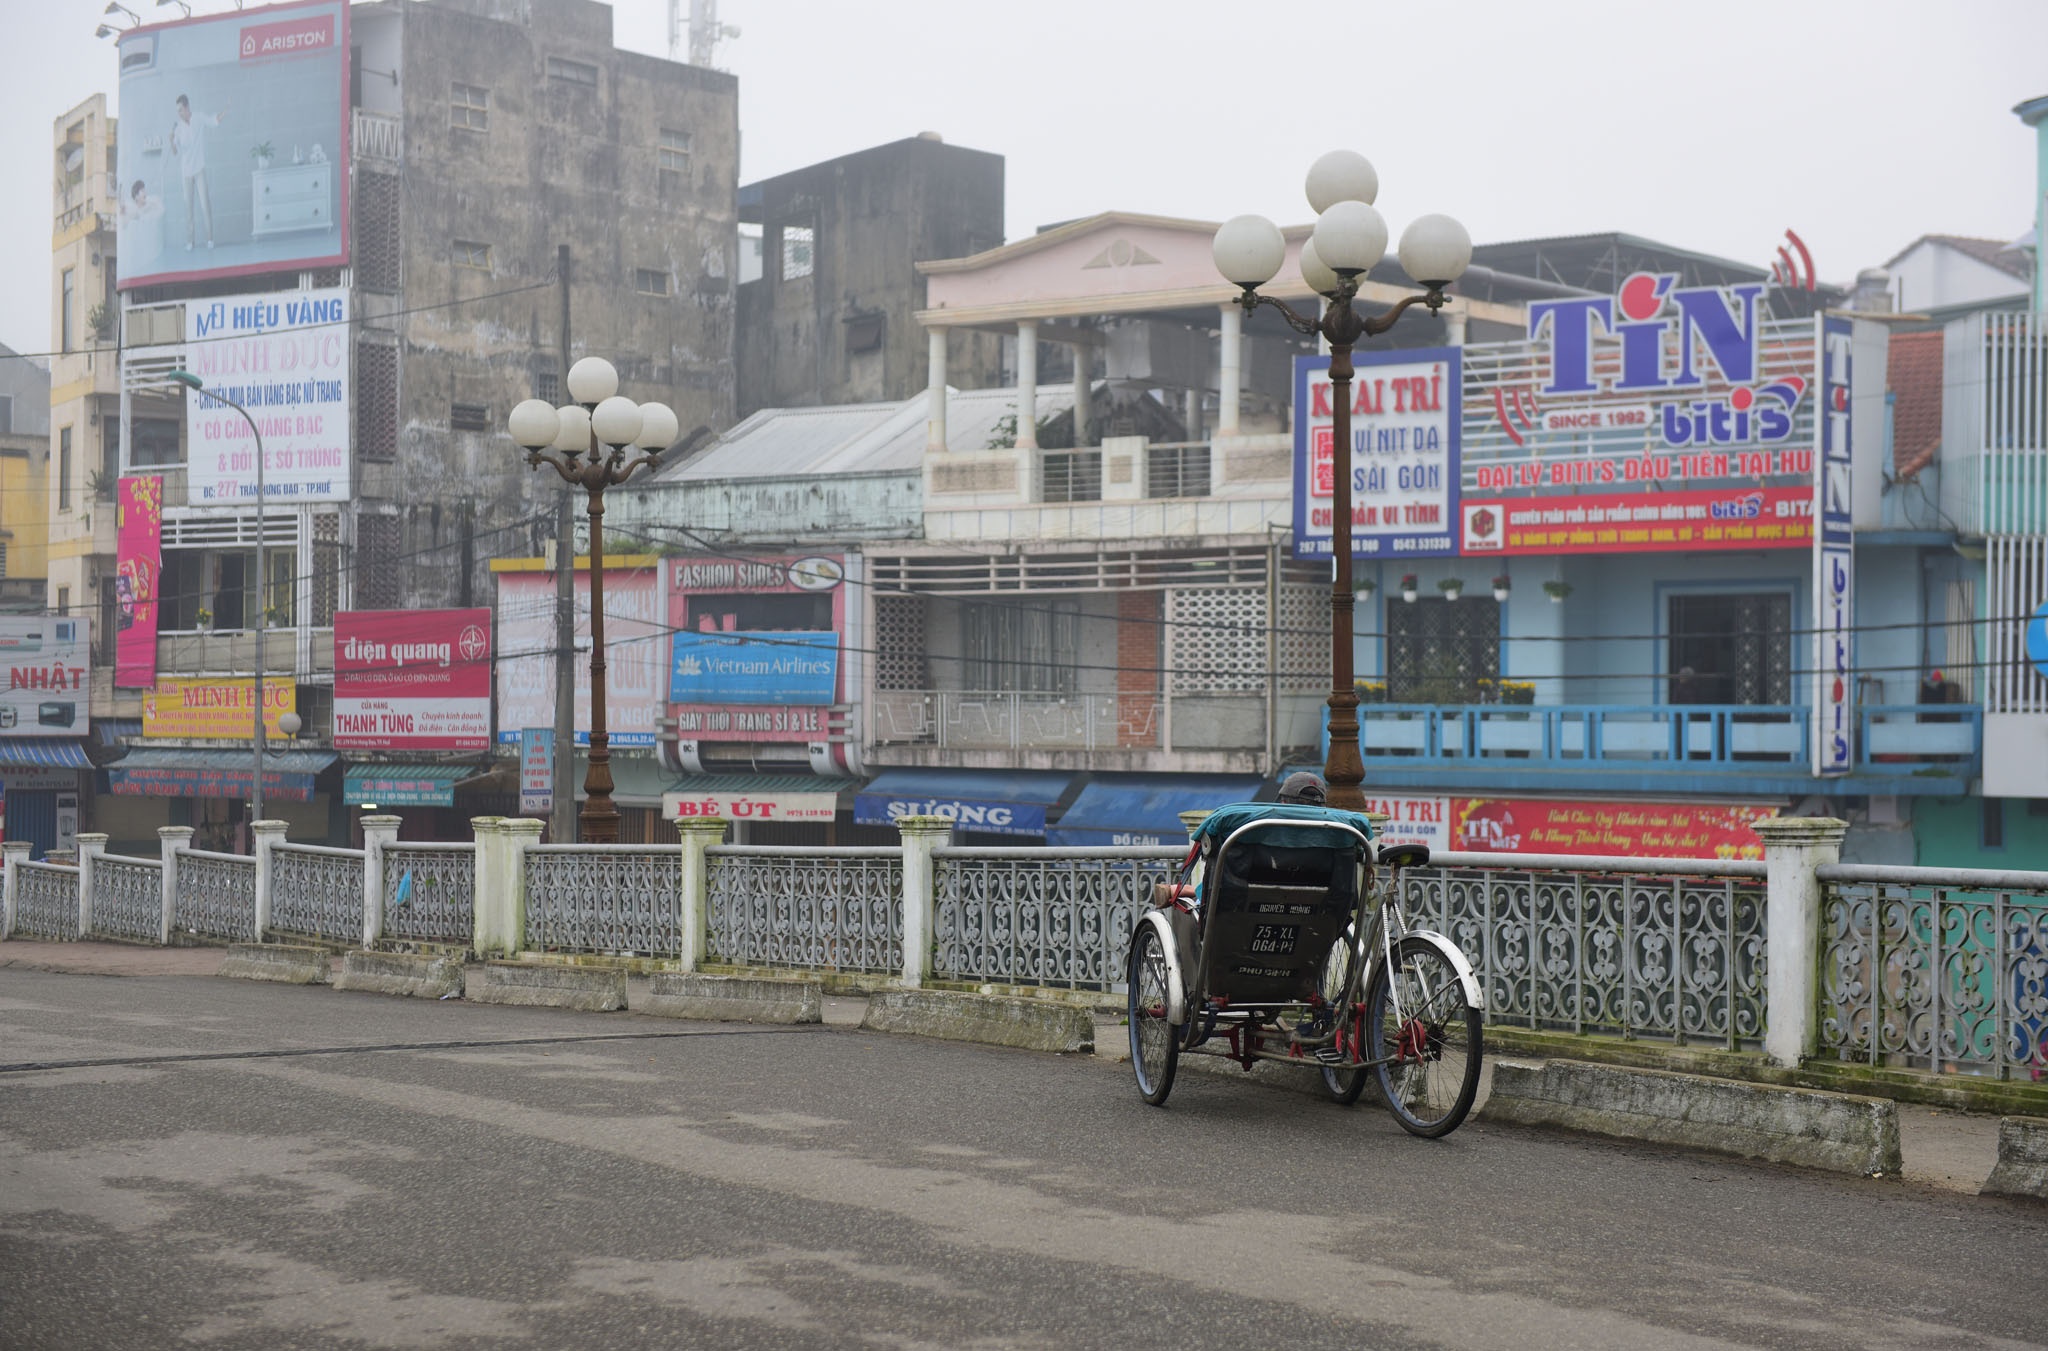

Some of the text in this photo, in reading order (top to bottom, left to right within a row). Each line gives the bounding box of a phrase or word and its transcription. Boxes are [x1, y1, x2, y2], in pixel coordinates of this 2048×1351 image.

[261, 30, 326, 52] ARISTON
[233, 301, 279, 335] HIỆU
[286, 297, 343, 325] VÀNG
[196, 340, 273, 377] MINH
[317, 381, 342, 403] TRANG
[1312, 364, 1441, 418] KAI TRÍ
[296, 415, 323, 440] BẠC
[1549, 408, 1648, 431] SINCE 1992
[1414, 426, 1440, 452] DA
[1398, 459, 1440, 492] GÒN
[1477, 464, 1514, 494] ĐẠI
[1550, 458, 1616, 486] BITI'S
[1624, 448, 1671, 482] ĐẦU
[1737, 450, 1773, 482] TẠI
[1780, 447, 1814, 476] HU
[217, 479, 239, 498] 277
[1403, 501, 1440, 524] TÍNH
[675, 562, 787, 590] FASHION SHOES
[338, 637, 451, 667] điện quang
[11, 661, 85, 694] NHẬT
[705, 656, 831, 675] Vietnam Airlines
[183, 686, 240, 708] MINH
[336, 708, 414, 734] THANH TÙNG
[421, 711, 445, 722] Chuyên
[733, 712, 772, 732] TRANG
[791, 712, 801, 732] &
[677, 798, 777, 818] BÉ ÚT
[887, 799, 1014, 826] SƯƠNG
[1365, 796, 1442, 822] HAI TRÍ
[1132, 834, 1160, 846] CÂU
